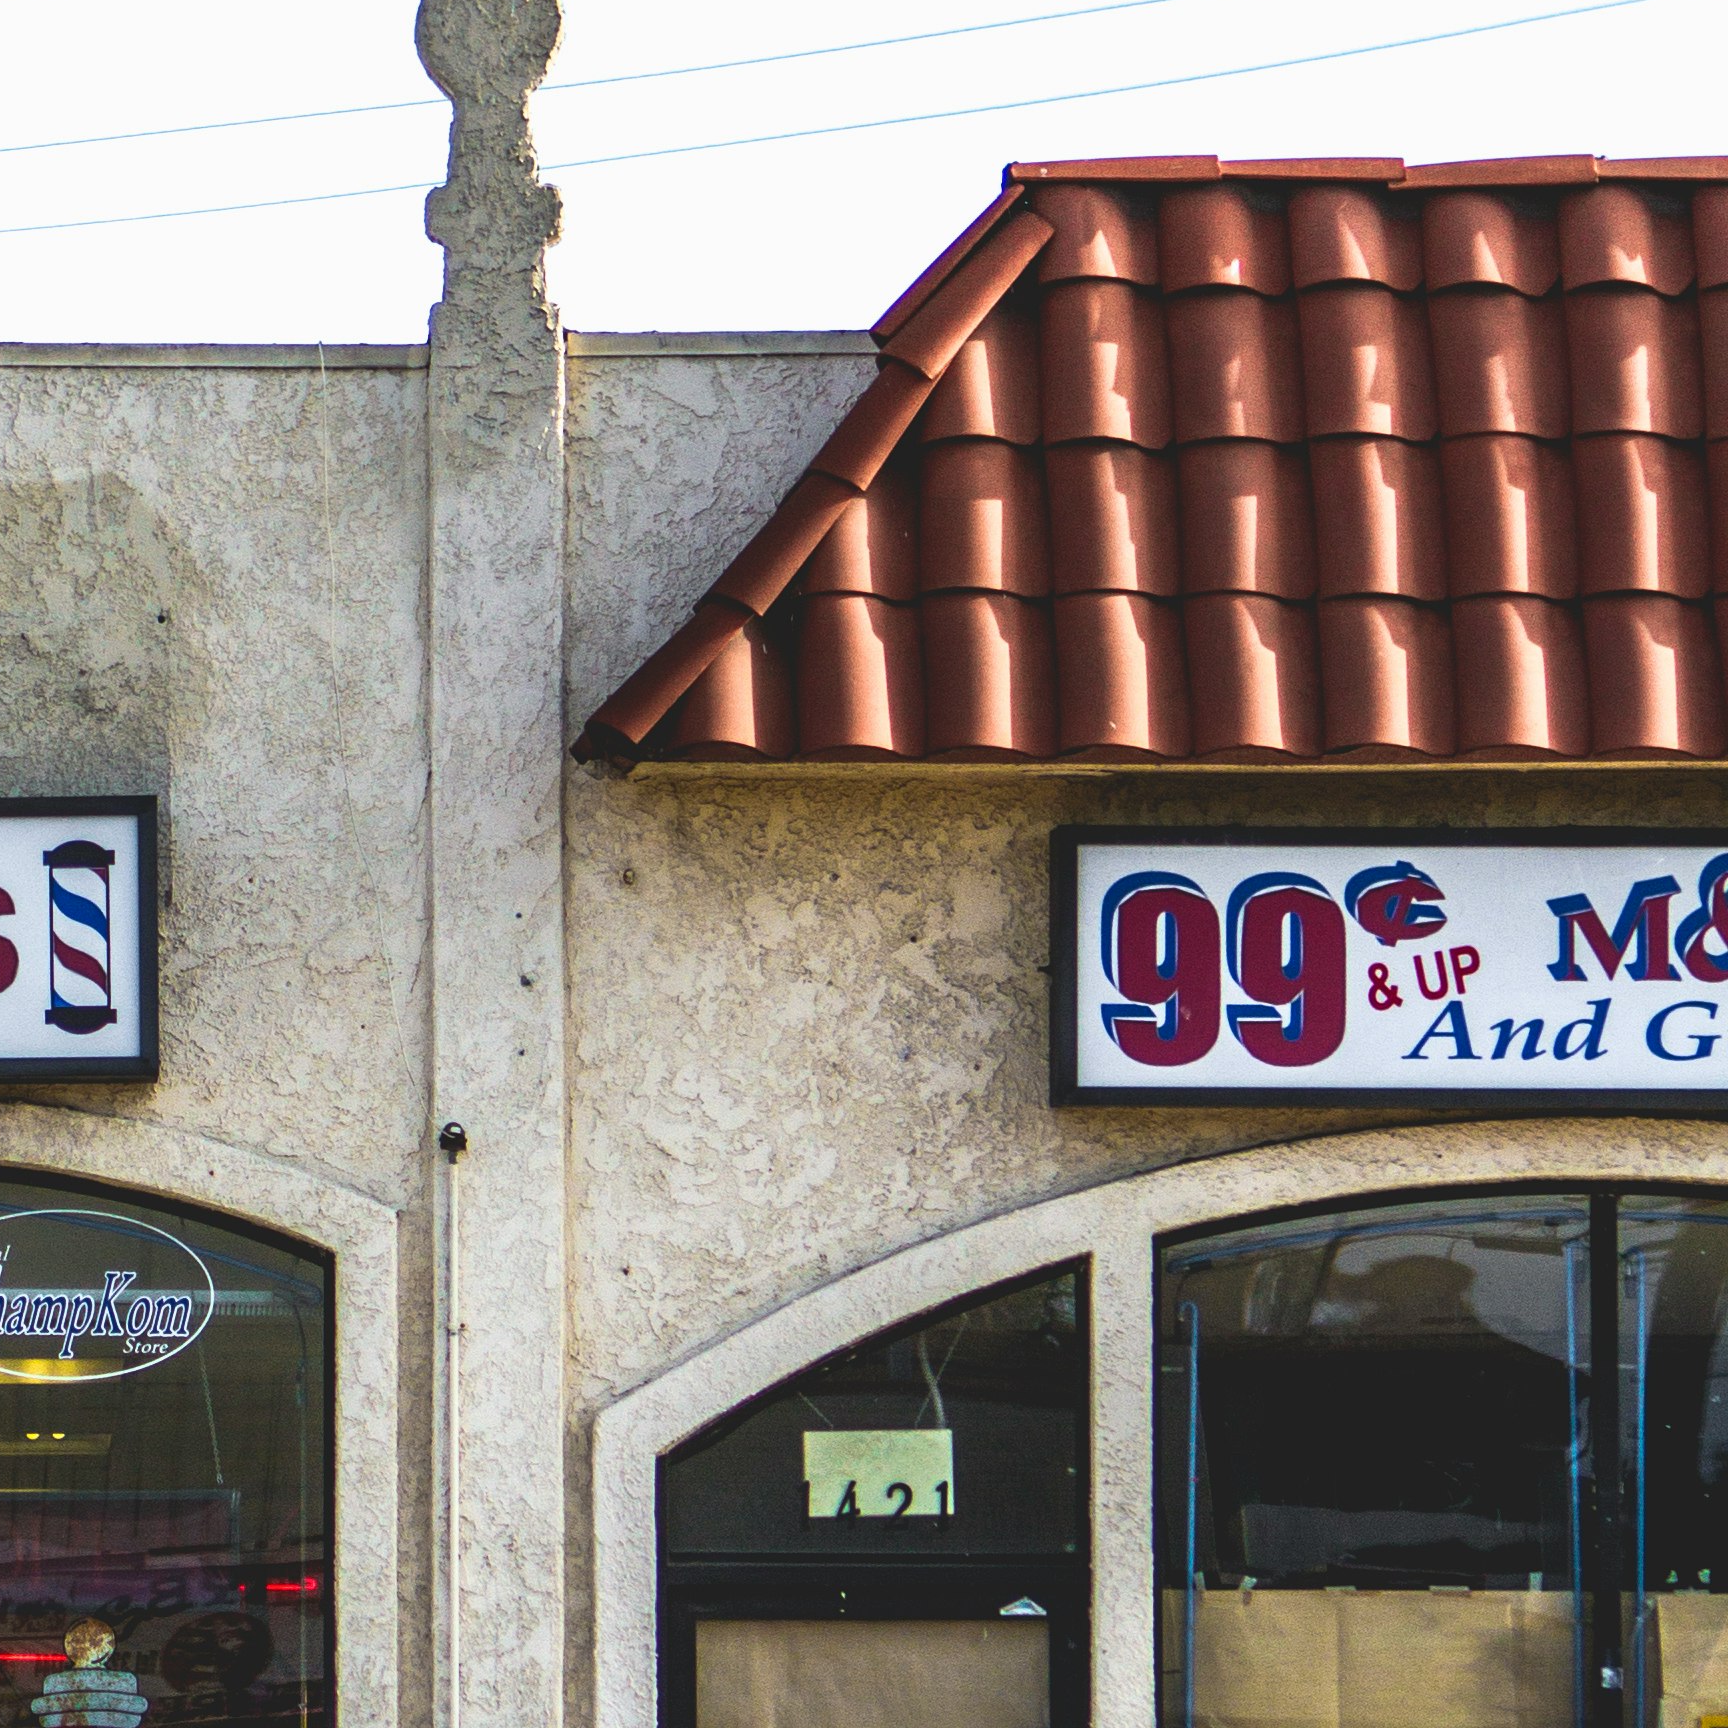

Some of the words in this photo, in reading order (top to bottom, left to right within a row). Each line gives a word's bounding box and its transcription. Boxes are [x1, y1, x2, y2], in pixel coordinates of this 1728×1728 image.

[1367, 962, 1403, 1011] &
[1413, 945, 1482, 1001] UP
[1401, 997, 1613, 1060] And
[122, 1337, 169, 1355] Store
[799, 1480, 950, 1530] 1421
